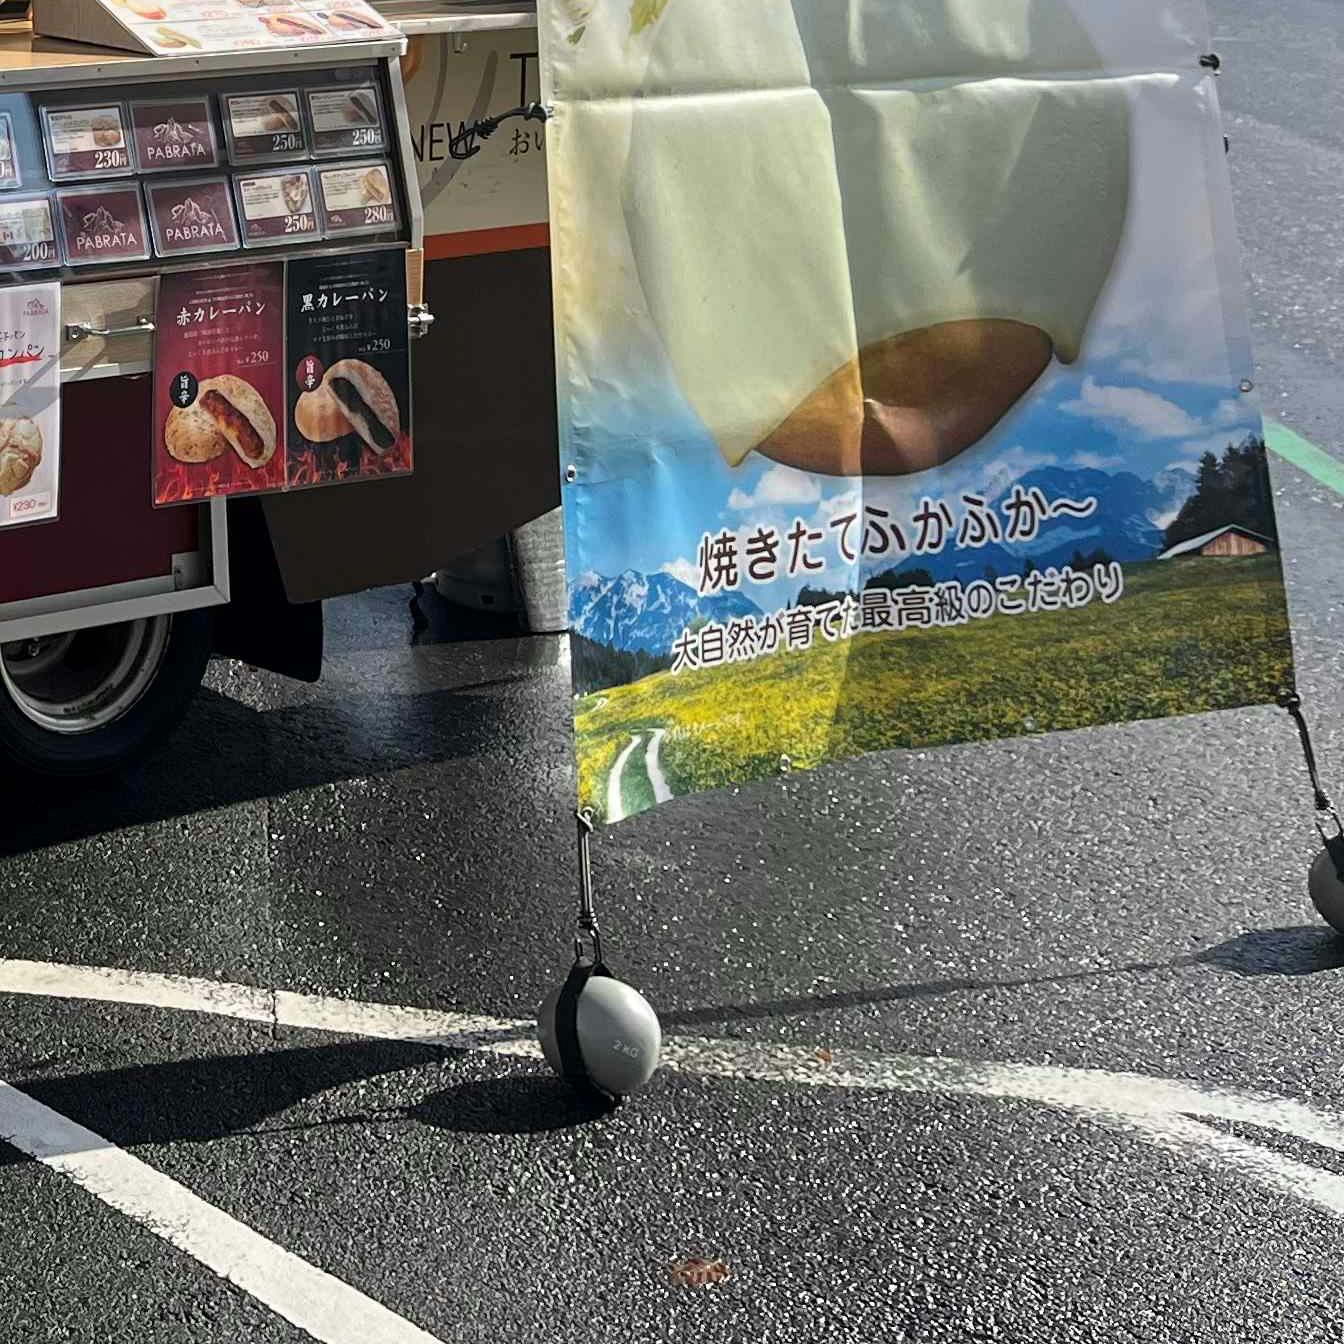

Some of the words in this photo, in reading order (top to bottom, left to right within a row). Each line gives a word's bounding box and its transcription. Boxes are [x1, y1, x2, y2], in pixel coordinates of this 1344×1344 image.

[147, 143, 206, 161] PABRATA
[75, 231, 138, 250] PABRATA
[166, 222, 226, 241] PABRATA
[300, 287, 389, 313] 黒カレーパン
[176, 301, 266, 327] 赤カレーパン
[669, 560, 1125, 675] 大自然が育てた最高級のこだわり
